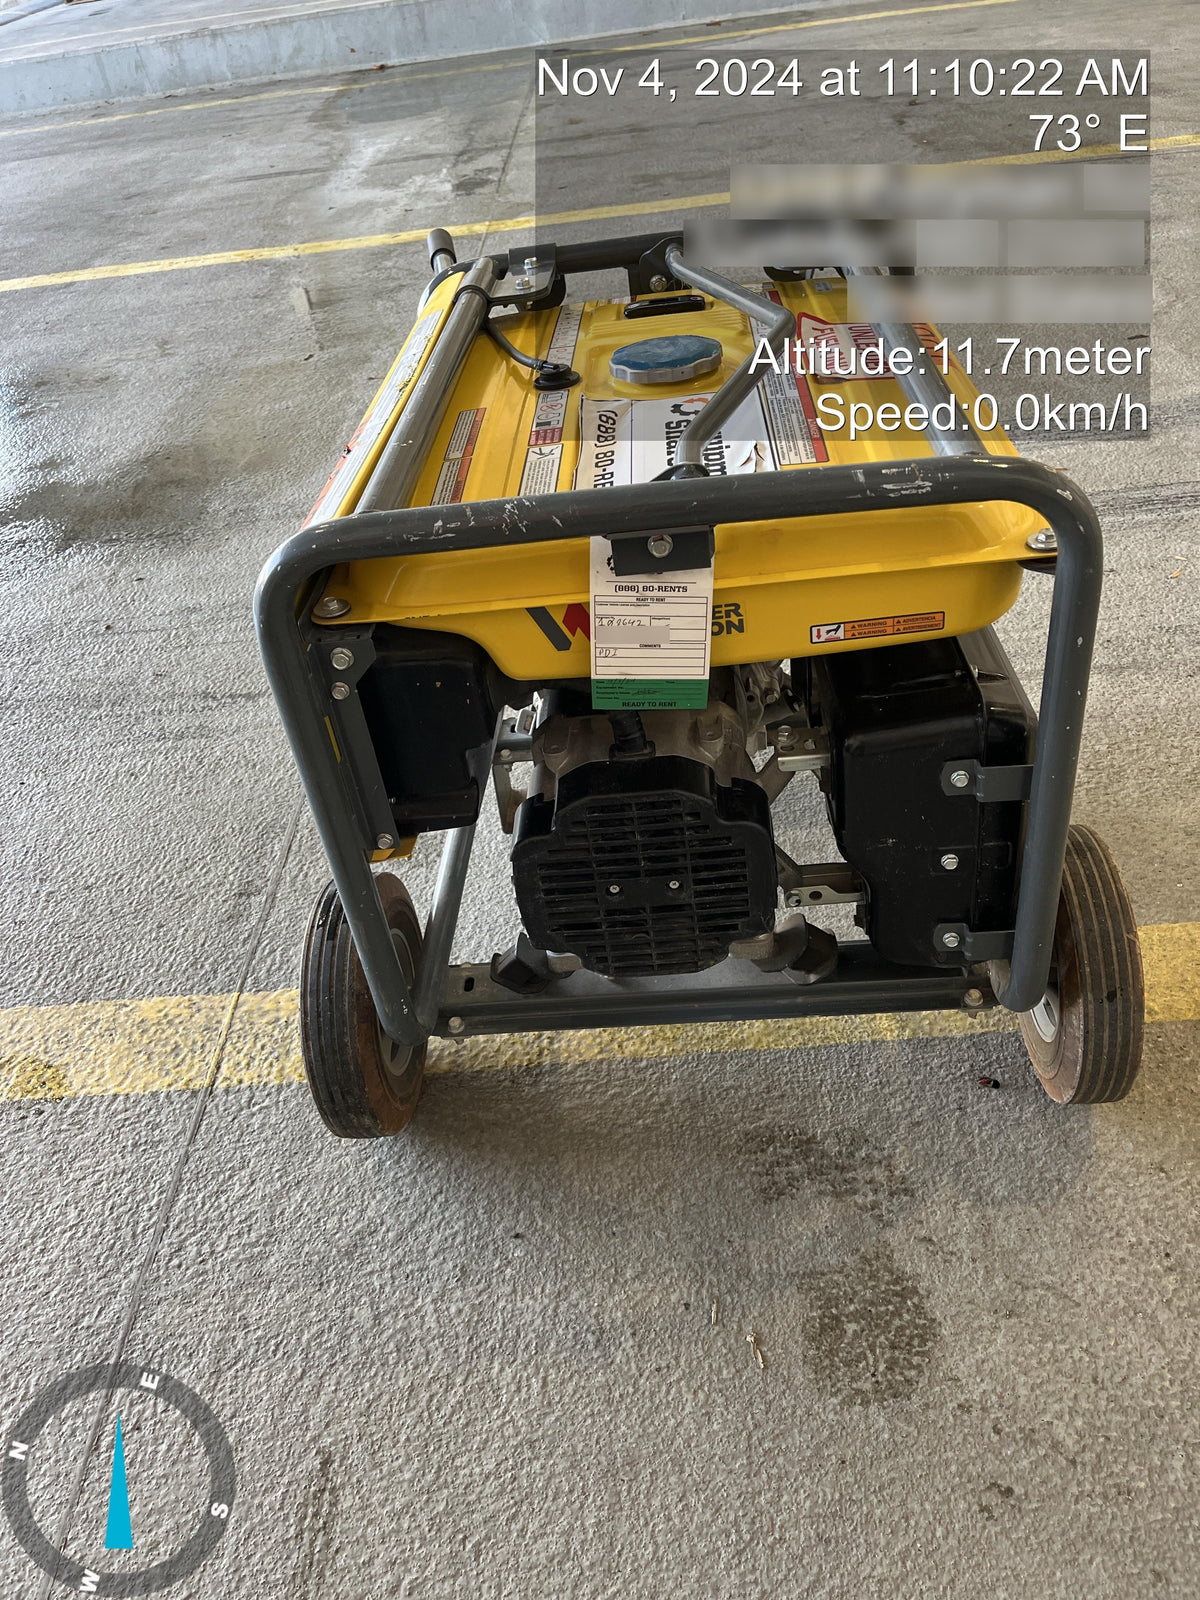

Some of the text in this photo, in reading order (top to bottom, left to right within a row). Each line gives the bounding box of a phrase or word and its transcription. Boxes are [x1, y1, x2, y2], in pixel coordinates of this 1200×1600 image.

[593, 444, 616, 484] 80-RE
[614, 584, 688, 594] (888) 80-RENTS
[857, 621, 888, 629] WARNING
